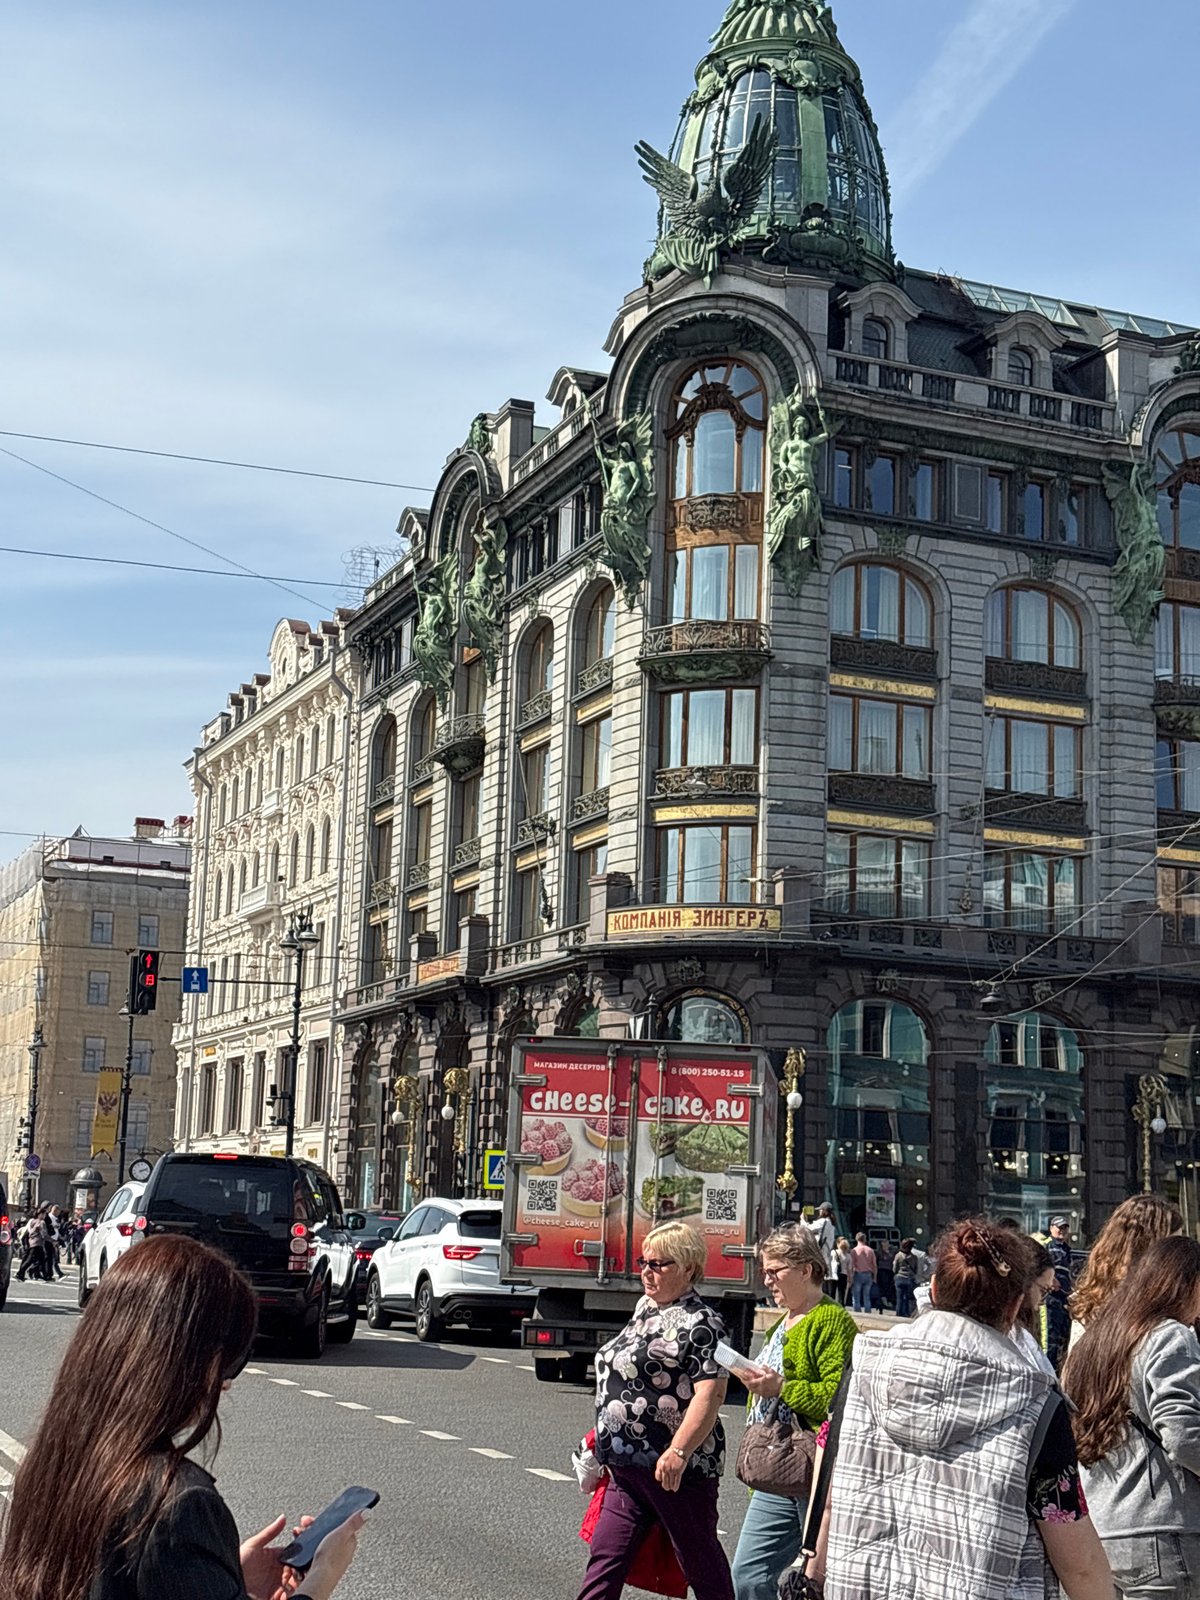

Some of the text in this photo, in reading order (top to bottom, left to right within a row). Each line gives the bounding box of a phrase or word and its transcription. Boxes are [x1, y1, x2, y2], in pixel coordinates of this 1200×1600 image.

[533, 1061, 606, 1071] МАГАЗИН ДЕСЕРТОВ
[671, 1067, 745, 1078] 8 (800) 250-51-15
[523, 1215, 600, 1230] @cheese_cake_ru
